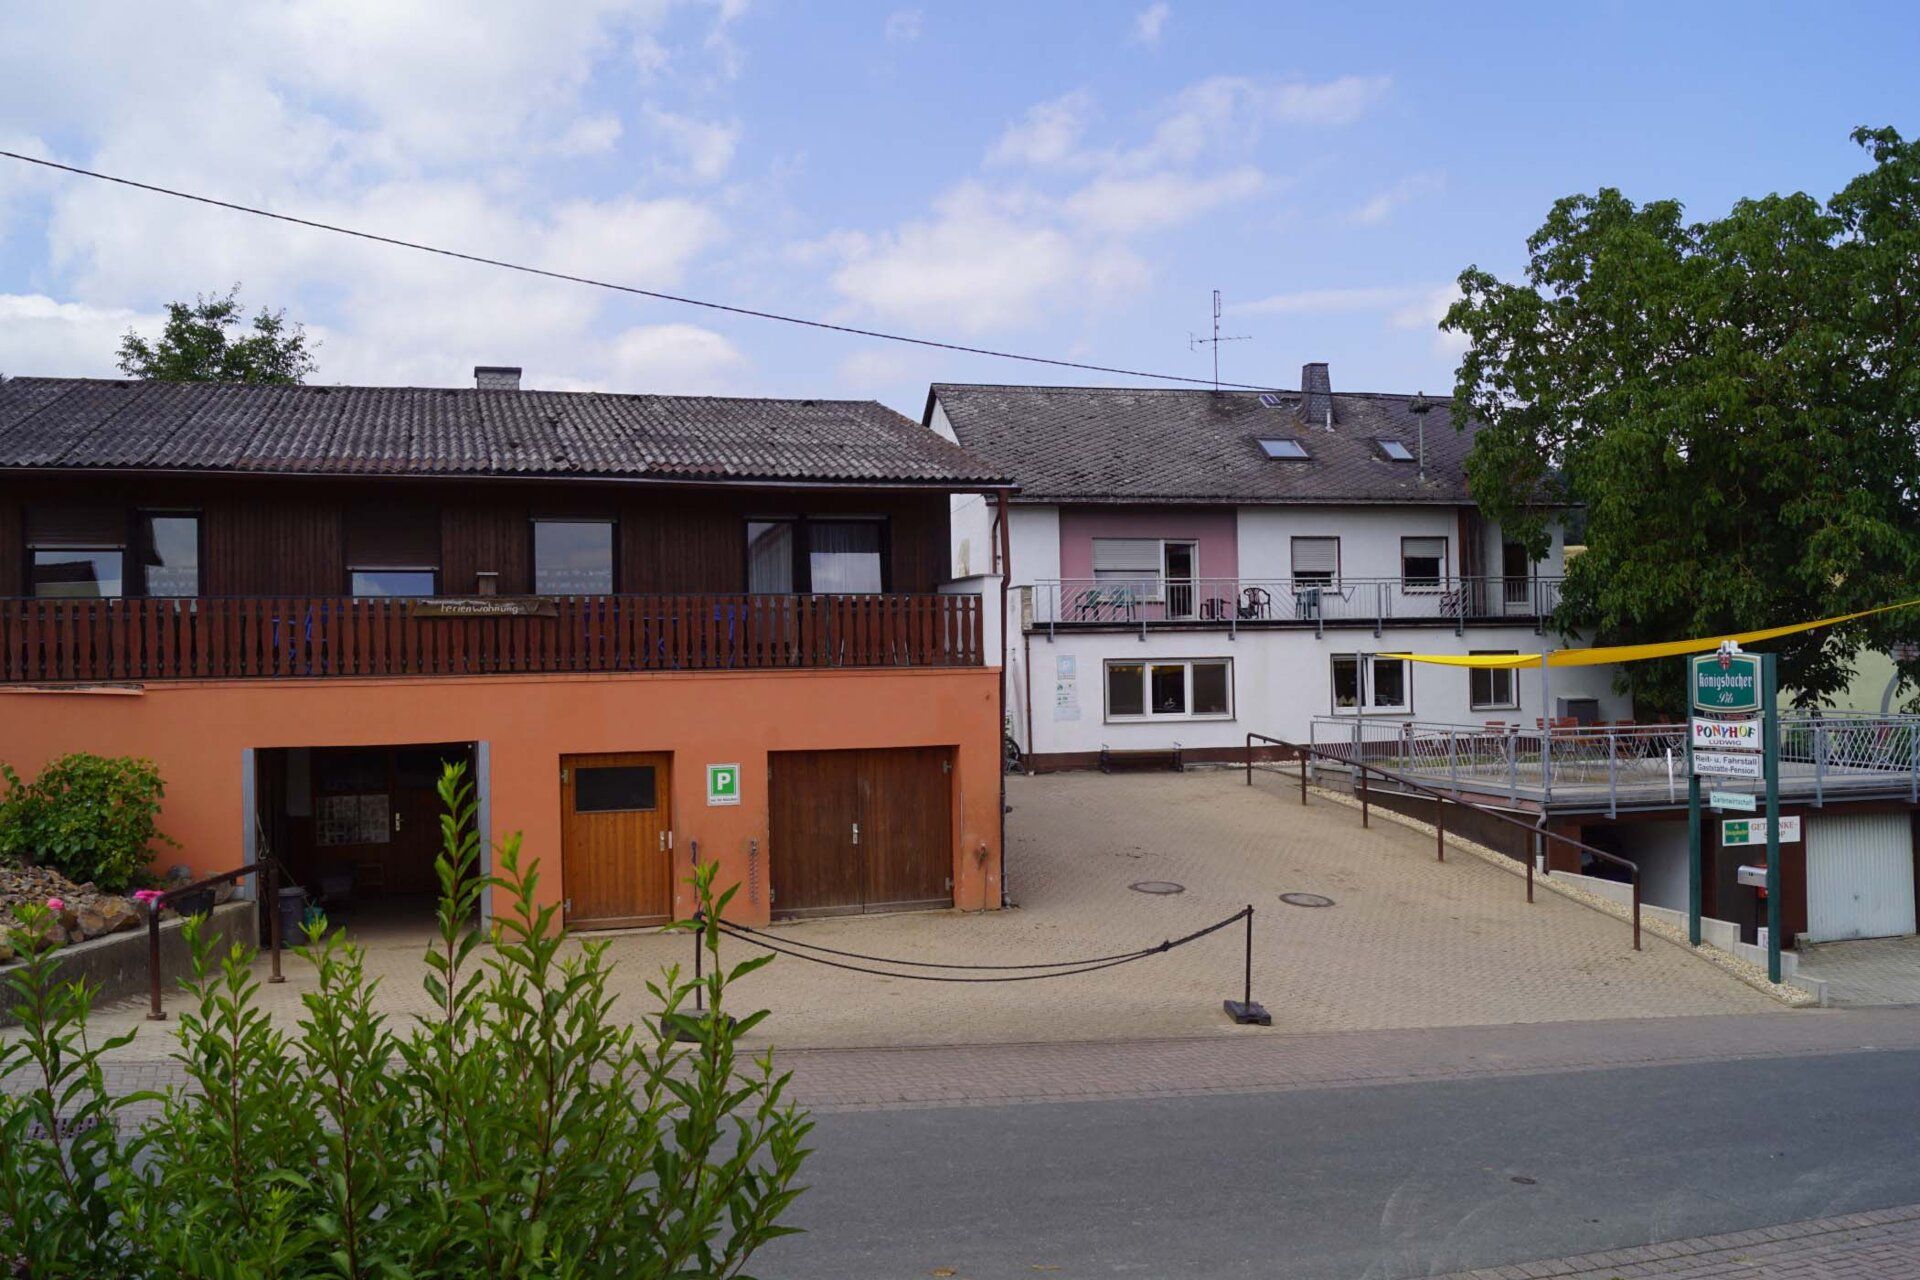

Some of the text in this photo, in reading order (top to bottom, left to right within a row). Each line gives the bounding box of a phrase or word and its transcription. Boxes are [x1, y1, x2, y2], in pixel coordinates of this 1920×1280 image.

[1698, 673, 1753, 690] Königsbacher
[1695, 723, 1757, 738] PONYHOF
[1695, 754, 1713, 763] Reit-
[1723, 757, 1757, 766] Fahrstall
[717, 772, 732, 791] P
